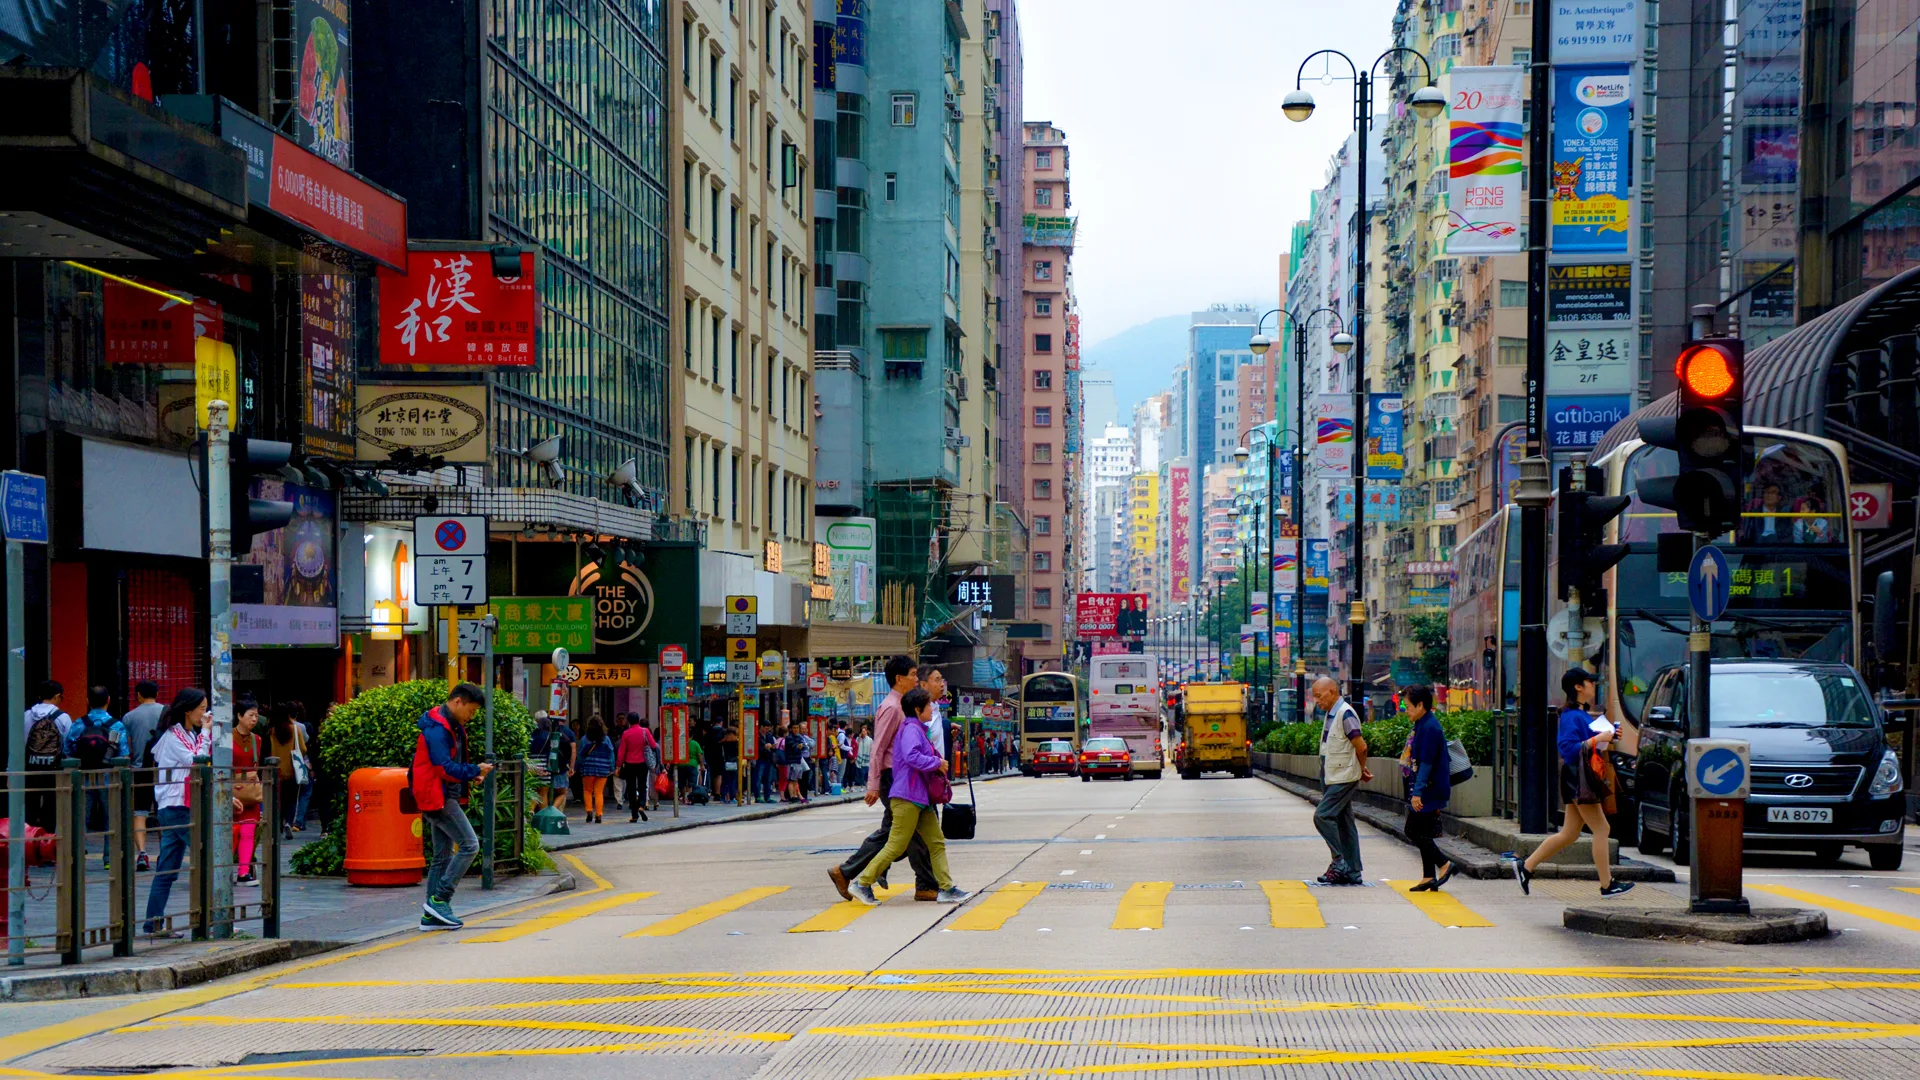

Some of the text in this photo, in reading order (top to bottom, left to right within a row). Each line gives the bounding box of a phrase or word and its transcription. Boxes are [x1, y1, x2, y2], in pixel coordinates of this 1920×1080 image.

[1559, 7, 1572, 15] Dr.
[1558, 34, 1633, 45] 66 919 919 17/F
[1453, 91, 1482, 110] 20
[1585, 153, 1618, 161] 二零一七
[1585, 162, 1617, 170] 香港公開
[1585, 171, 1617, 181] 羽毛球
[1465, 187, 1503, 196] HONG
[1585, 182, 1617, 192] 錦標賽
[1465, 197, 1503, 206] KONG
[1556, 301, 1624, 309] menceladies.com.hk
[1549, 338, 1619, 361] 金皇廷
[498, 354, 527, 362] Buffet
[1580, 374, 1598, 383] 2/F
[1320, 403, 1333, 413] 20
[377, 406, 452, 424] 北京同仁堂
[1555, 406, 1623, 424] citibank
[374, 427, 458, 437] BEIJING TONG REN TANG
[1556, 430, 1604, 444] 花旗銀
[430, 566, 450, 576] 上午
[461, 560, 473, 575] 7
[1668, 567, 1794, 596] 尖碼頭 1
[434, 583, 473, 600] pm 7
[596, 586, 625, 598] THE
[958, 581, 992, 603] 周生生
[1729, 586, 1752, 595] ERRY
[431, 592, 450, 600] 下午
[597, 599, 637, 613] ODY
[470, 622, 479, 633] 7
[470, 640, 478, 651] 7
[584, 668, 631, 680] 元気寿司
[732, 672, 750, 680] 終止
[1772, 809, 1828, 821] VA 8079
